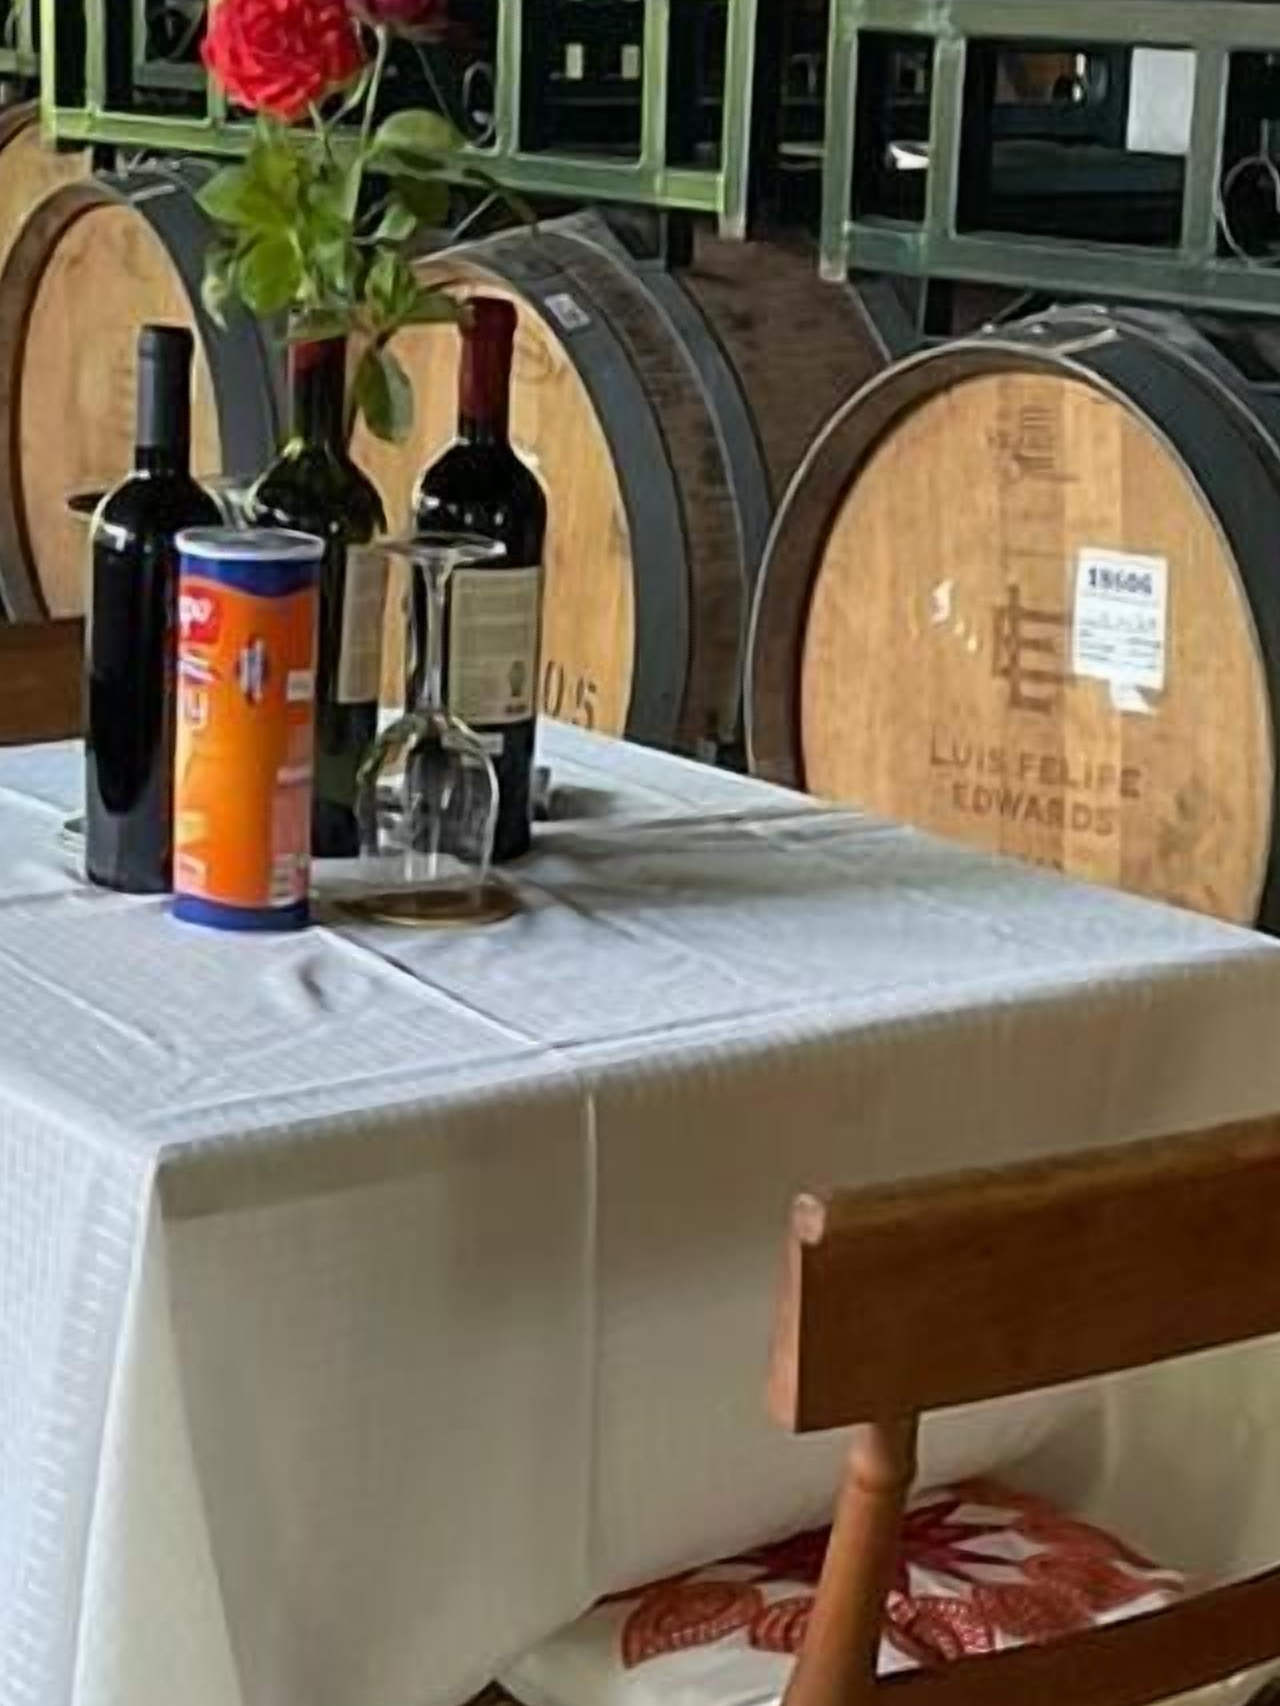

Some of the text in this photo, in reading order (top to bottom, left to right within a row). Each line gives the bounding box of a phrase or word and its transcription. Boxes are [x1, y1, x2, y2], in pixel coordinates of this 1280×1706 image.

[929, 725, 1142, 799] LUIS FELIPE
[952, 782, 1115, 837] EDWARDS
